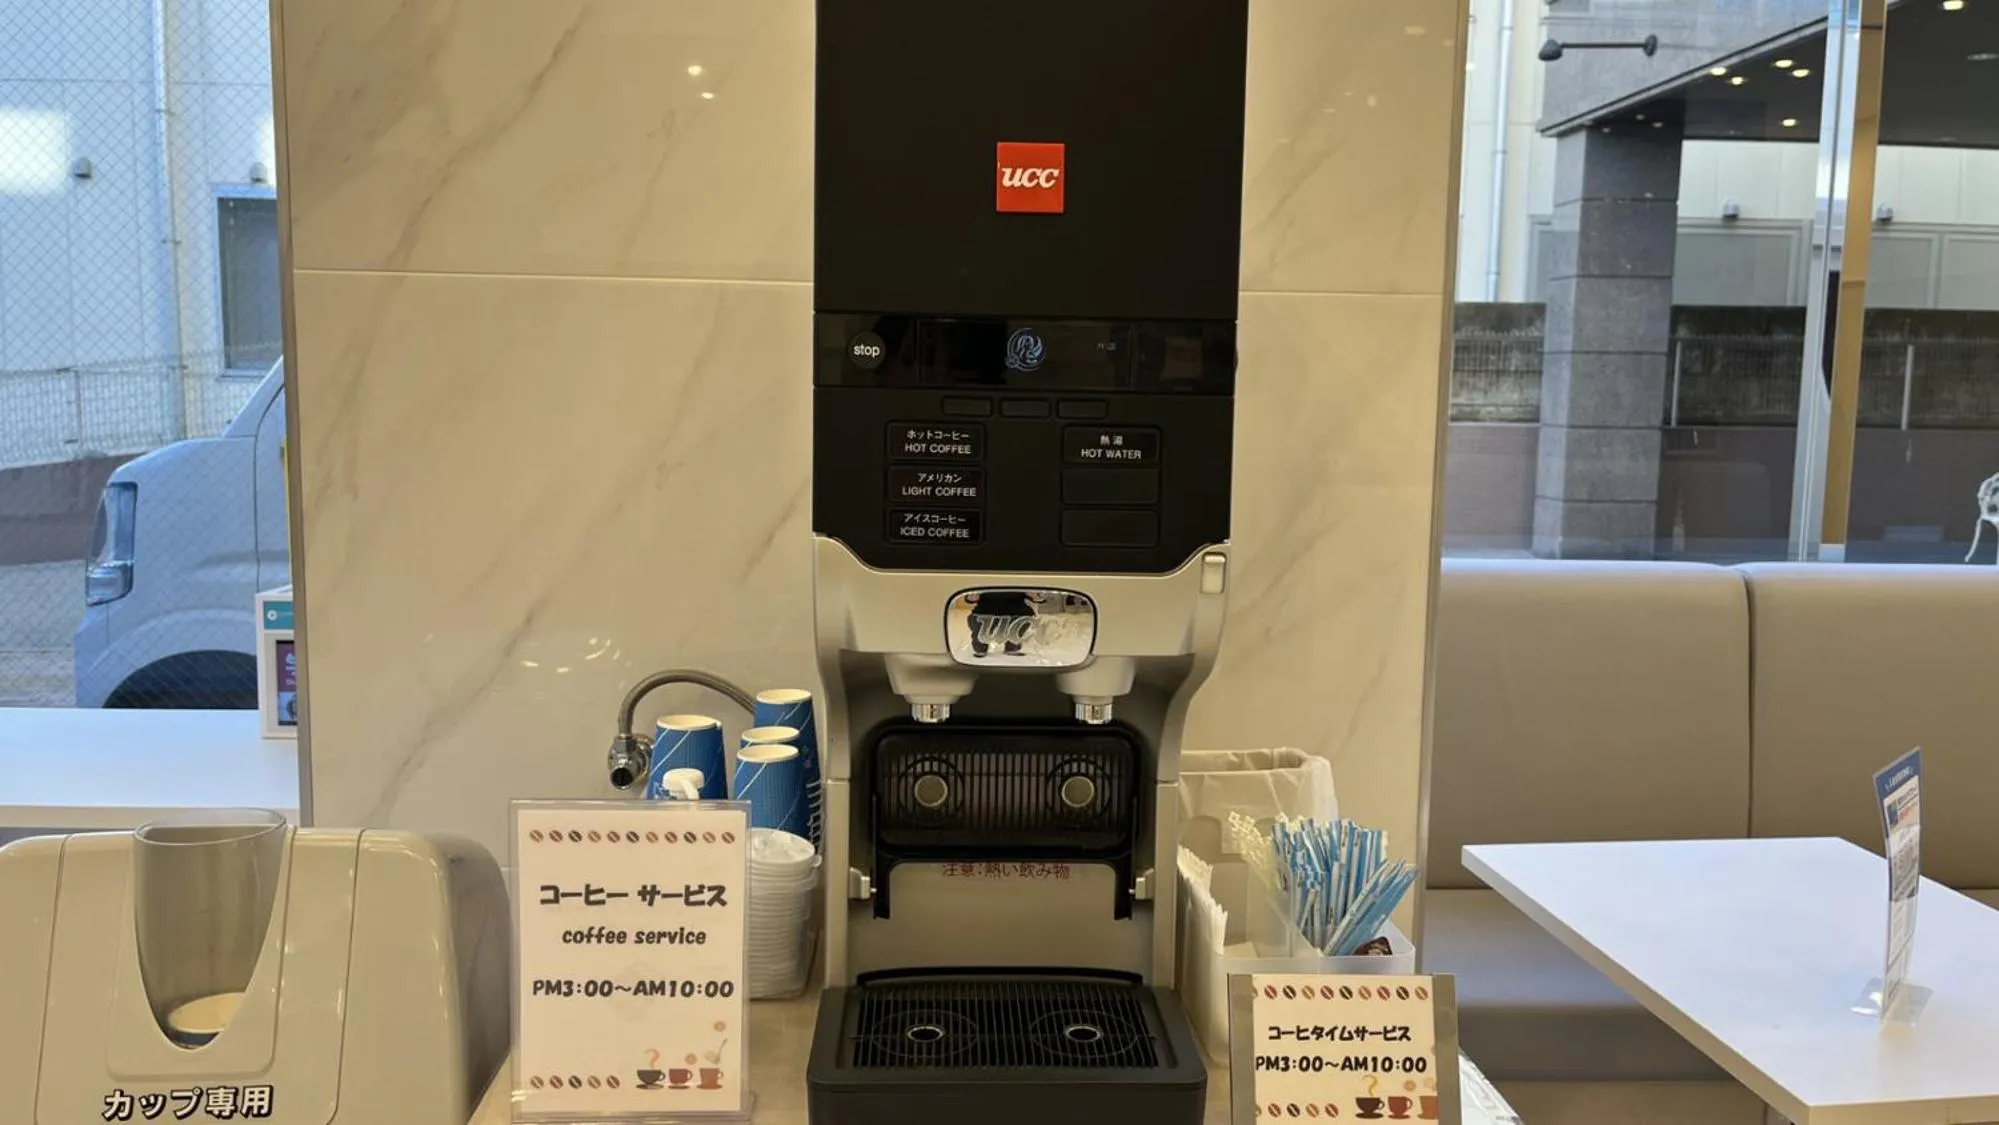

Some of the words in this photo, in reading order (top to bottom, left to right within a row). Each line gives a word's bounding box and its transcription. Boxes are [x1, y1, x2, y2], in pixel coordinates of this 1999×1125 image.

[853, 342, 881, 358] stop
[906, 430, 970, 441] ホットコーヒー
[904, 443, 927, 453] HOT
[929, 443, 972, 454] COFFEE
[1081, 448, 1103, 458] HOT
[1105, 449, 1142, 460] WATER
[917, 472, 962, 483] アメリカン
[901, 486, 932, 496] LIGHT
[935, 486, 977, 497] COFFEE
[903, 513, 967, 525] アイスコーヒー
[900, 526, 925, 537] ICED
[927, 527, 971, 538] COFFEE
[539, 884, 629, 906] コーヒー
[637, 884, 728, 907] サービス
[562, 927, 627, 945] coffee
[634, 927, 707, 945] service
[1268, 1025, 1412, 1042] コーヒタイムサービス
[102, 1085, 275, 1122] カップ専用
